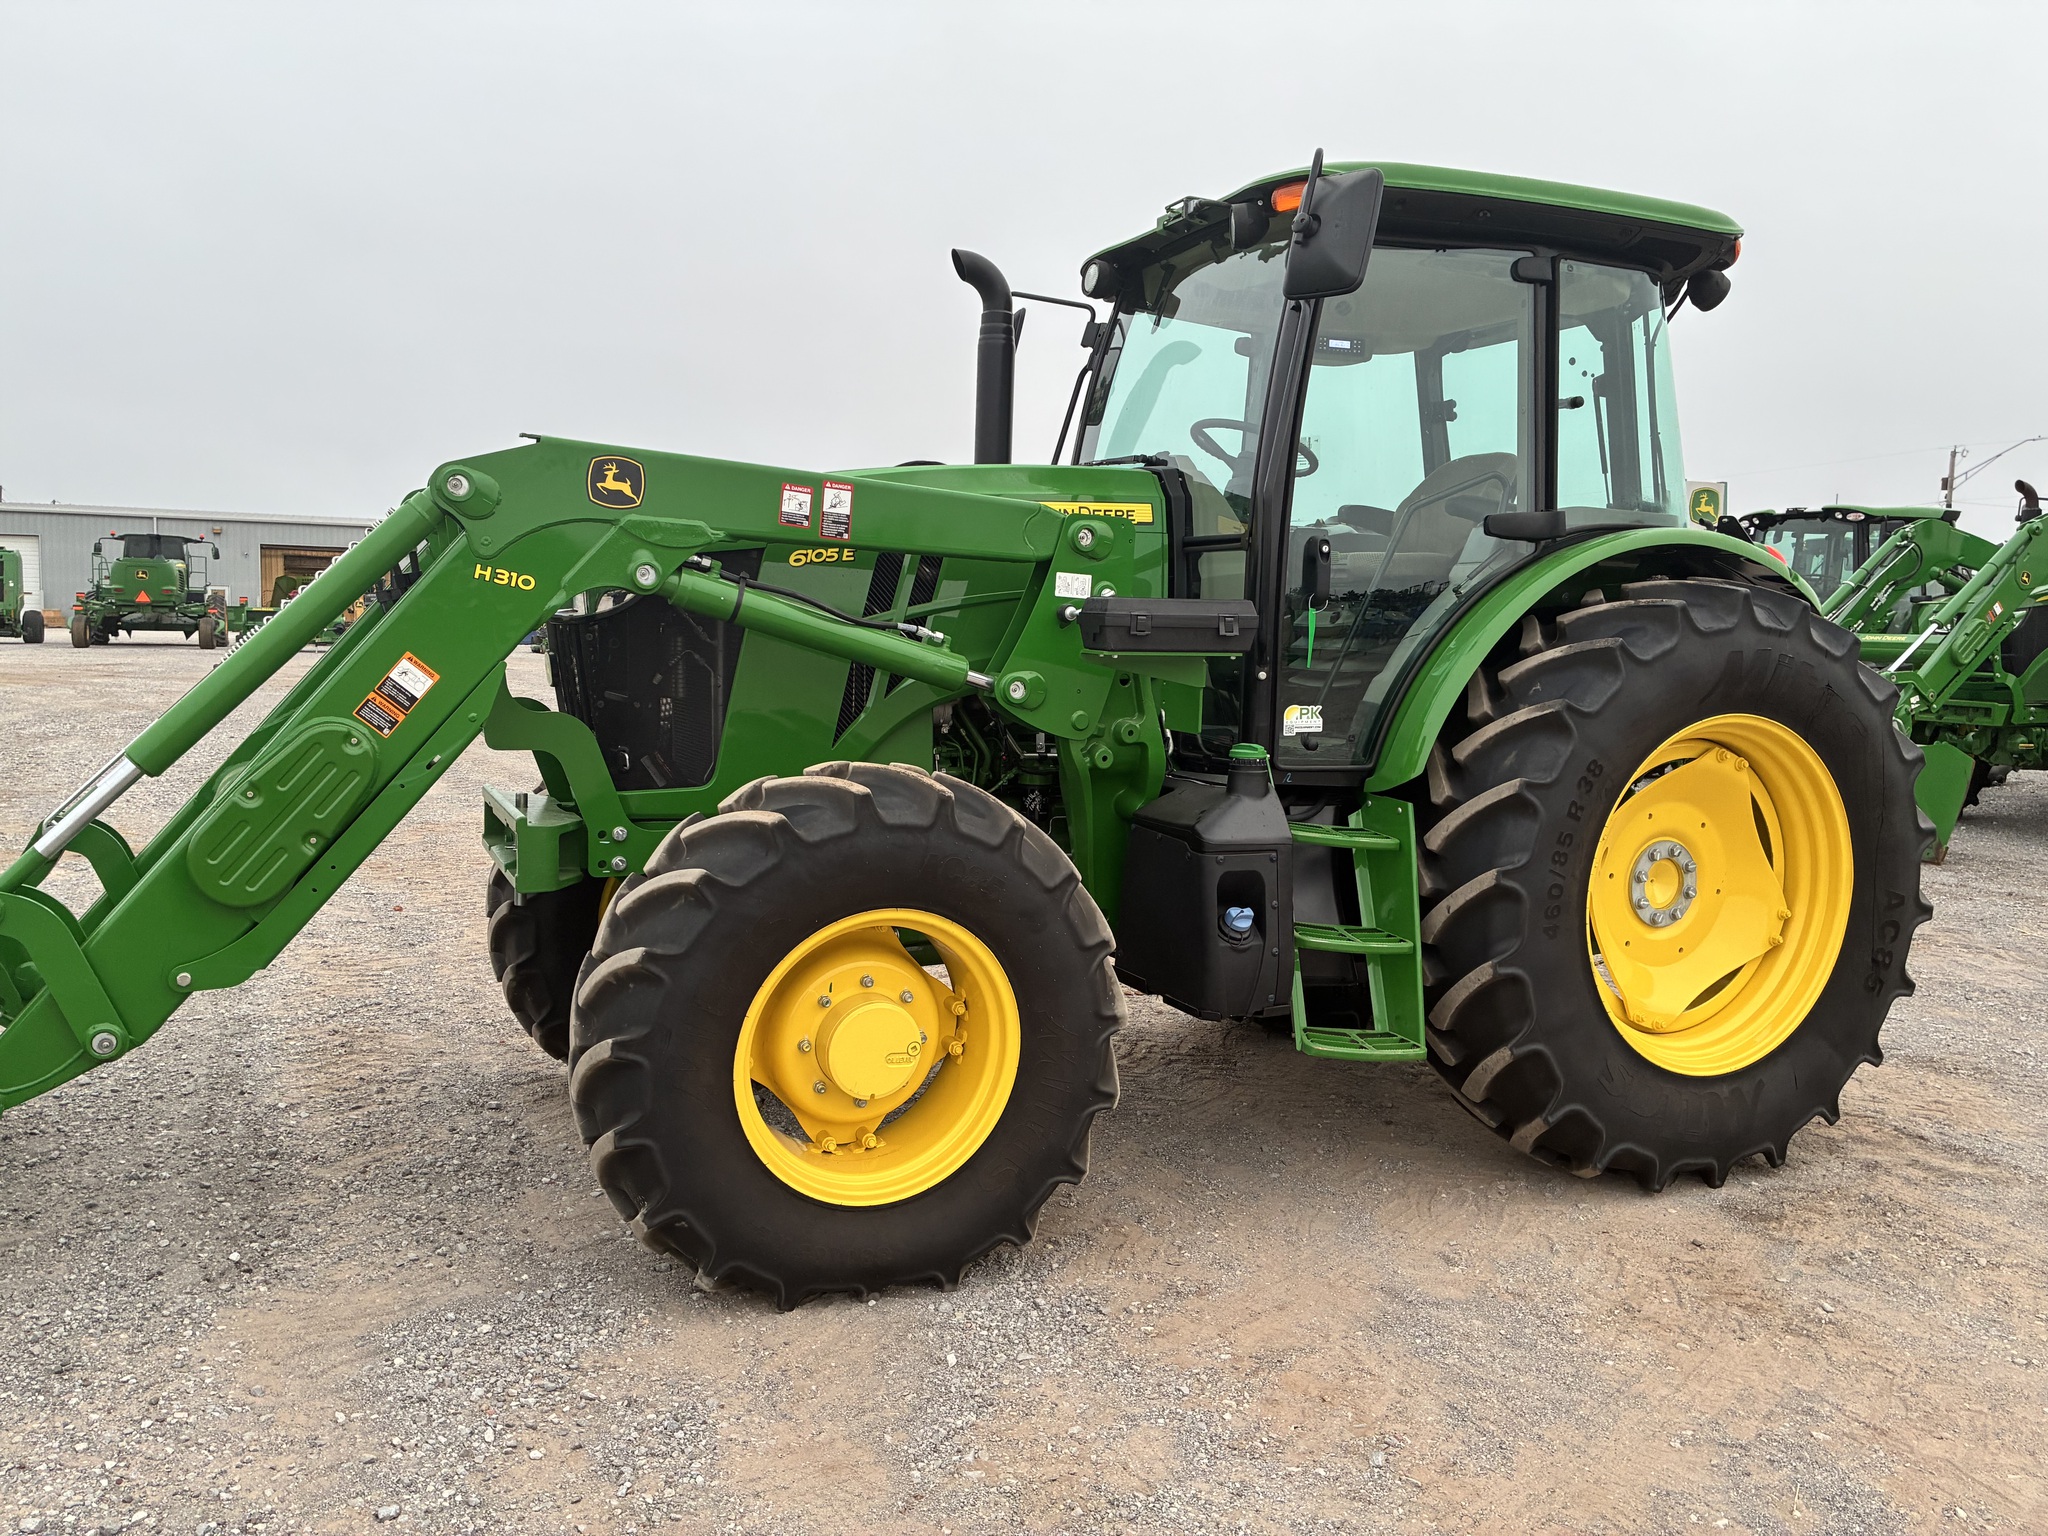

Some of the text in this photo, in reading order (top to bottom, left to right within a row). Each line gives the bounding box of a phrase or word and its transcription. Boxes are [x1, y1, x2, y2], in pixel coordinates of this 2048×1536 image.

[791, 485, 811, 493] DANGER
[788, 547, 856, 567] 6105 E
[473, 563, 536, 591] H310
[413, 659, 435, 679] WARNING
[378, 701, 400, 719] WARNING
[1543, 759, 1604, 941] 460/85 R 38
[1864, 889, 1905, 998] AC85
